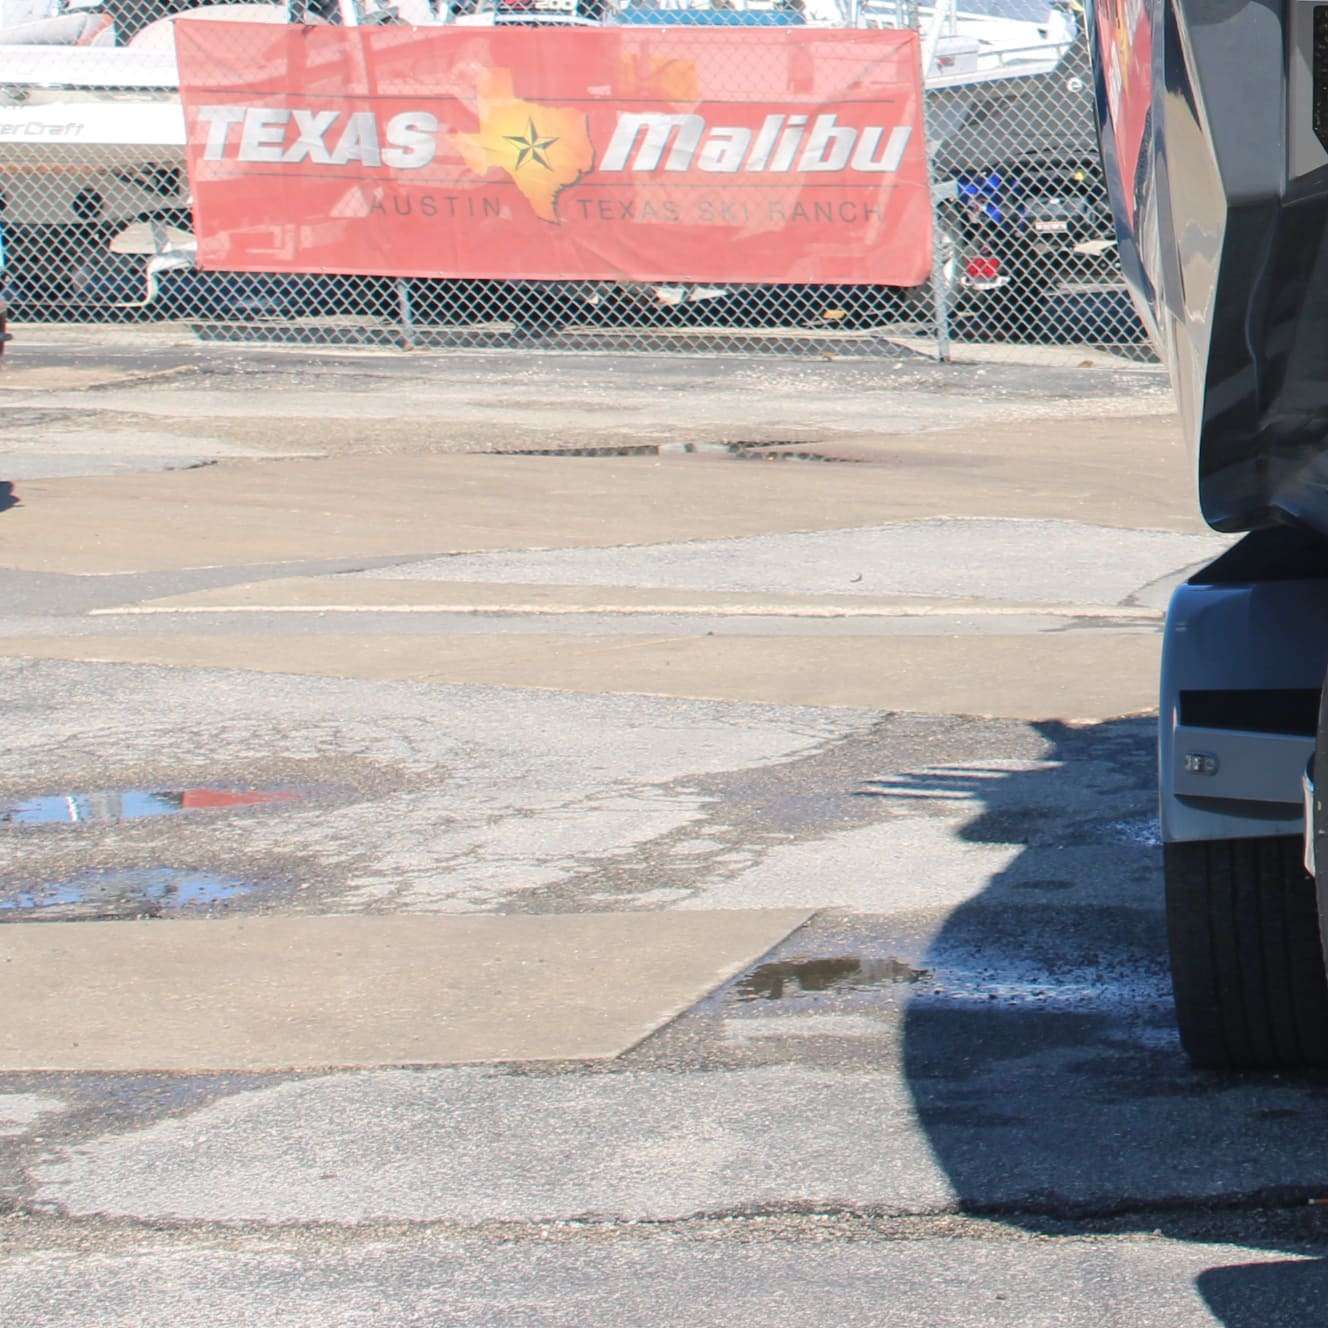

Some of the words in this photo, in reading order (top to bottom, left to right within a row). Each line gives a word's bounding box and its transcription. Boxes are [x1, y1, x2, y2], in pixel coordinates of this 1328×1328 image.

[197, 105, 439, 169] TEXAS
[599, 110, 913, 172] Malibu
[370, 196, 501, 219] AUSTIN
[576, 199, 680, 223] TEXAS
[699, 200, 749, 223] SKI
[768, 201, 883, 223] RANCH
